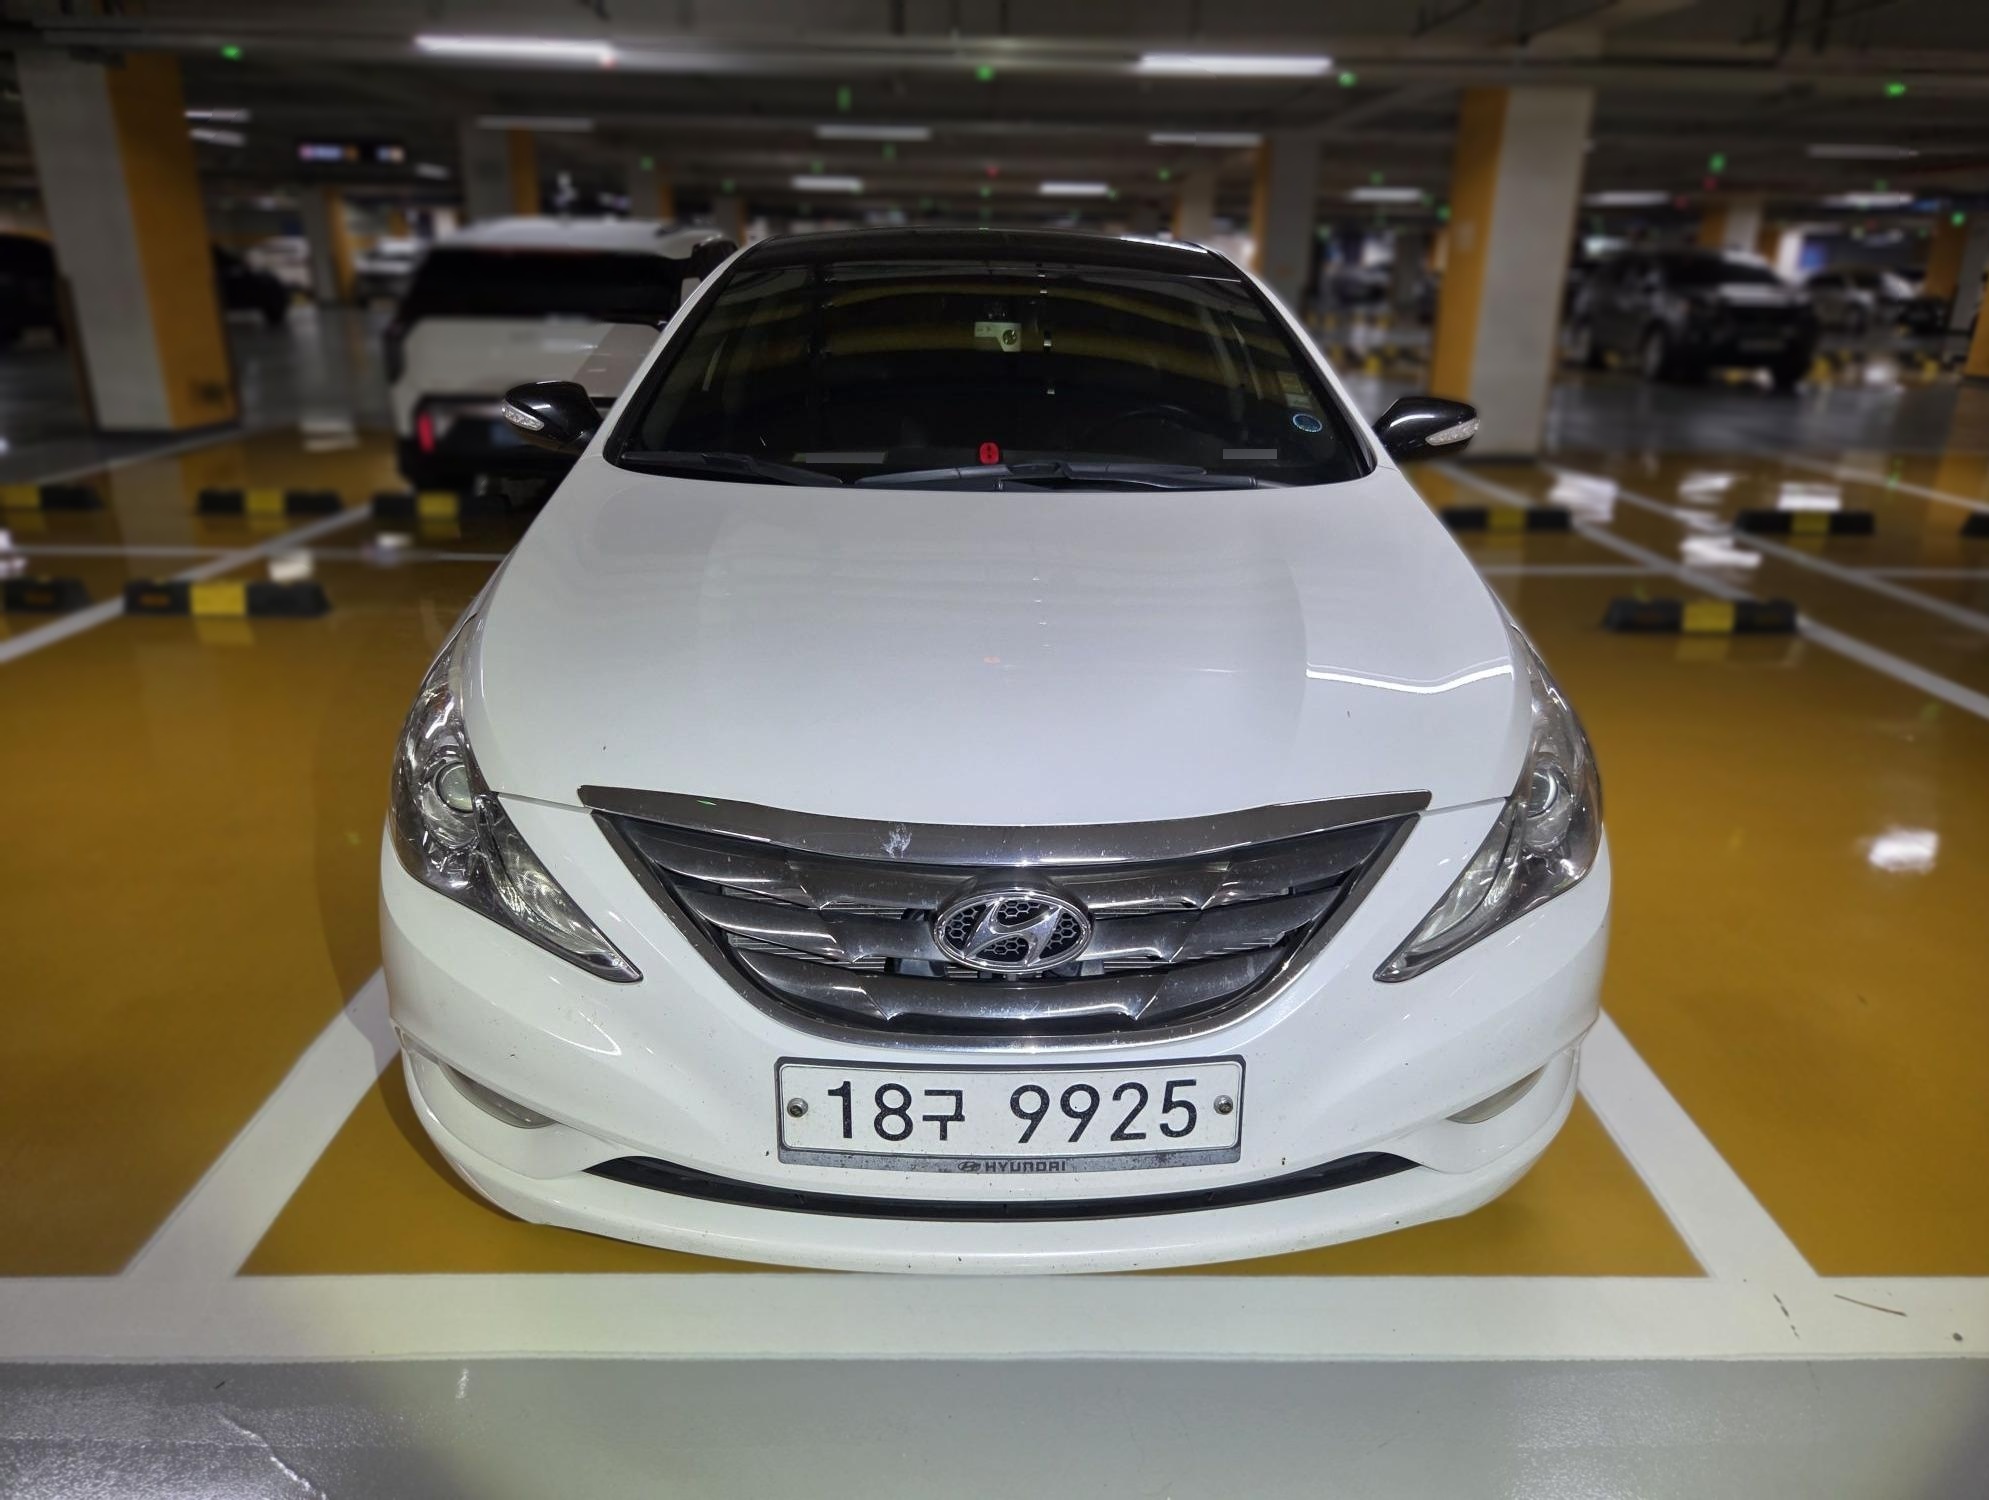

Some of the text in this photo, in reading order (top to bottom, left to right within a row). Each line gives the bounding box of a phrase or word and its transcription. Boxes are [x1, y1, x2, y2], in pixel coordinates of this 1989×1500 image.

[827, 1079, 1198, 1144] 18구 9925
[985, 1160, 1066, 1173] HYUNDAI
